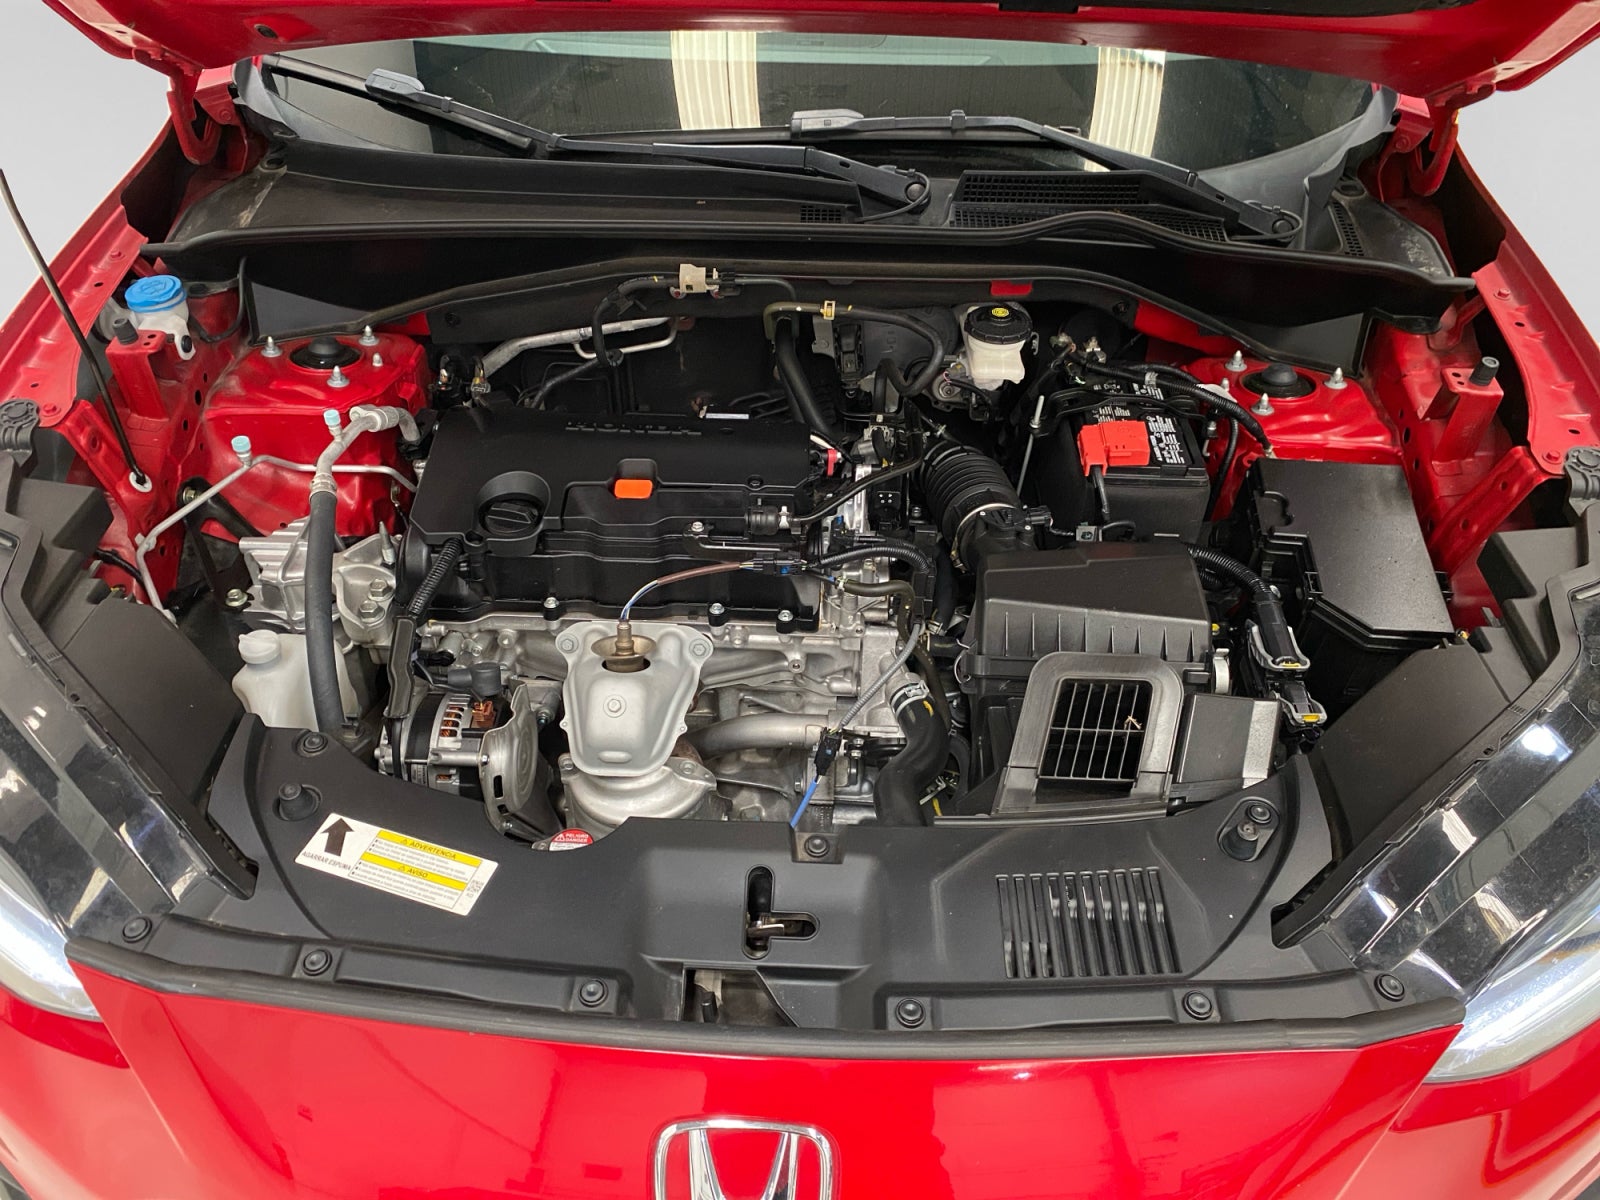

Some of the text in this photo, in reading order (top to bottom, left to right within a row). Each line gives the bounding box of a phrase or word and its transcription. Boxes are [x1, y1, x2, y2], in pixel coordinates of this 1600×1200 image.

[410, 842, 457, 860] ADVERTENCIA
[303, 851, 352, 871] AGARRAR ESPUMA
[407, 868, 429, 878] AVISO
